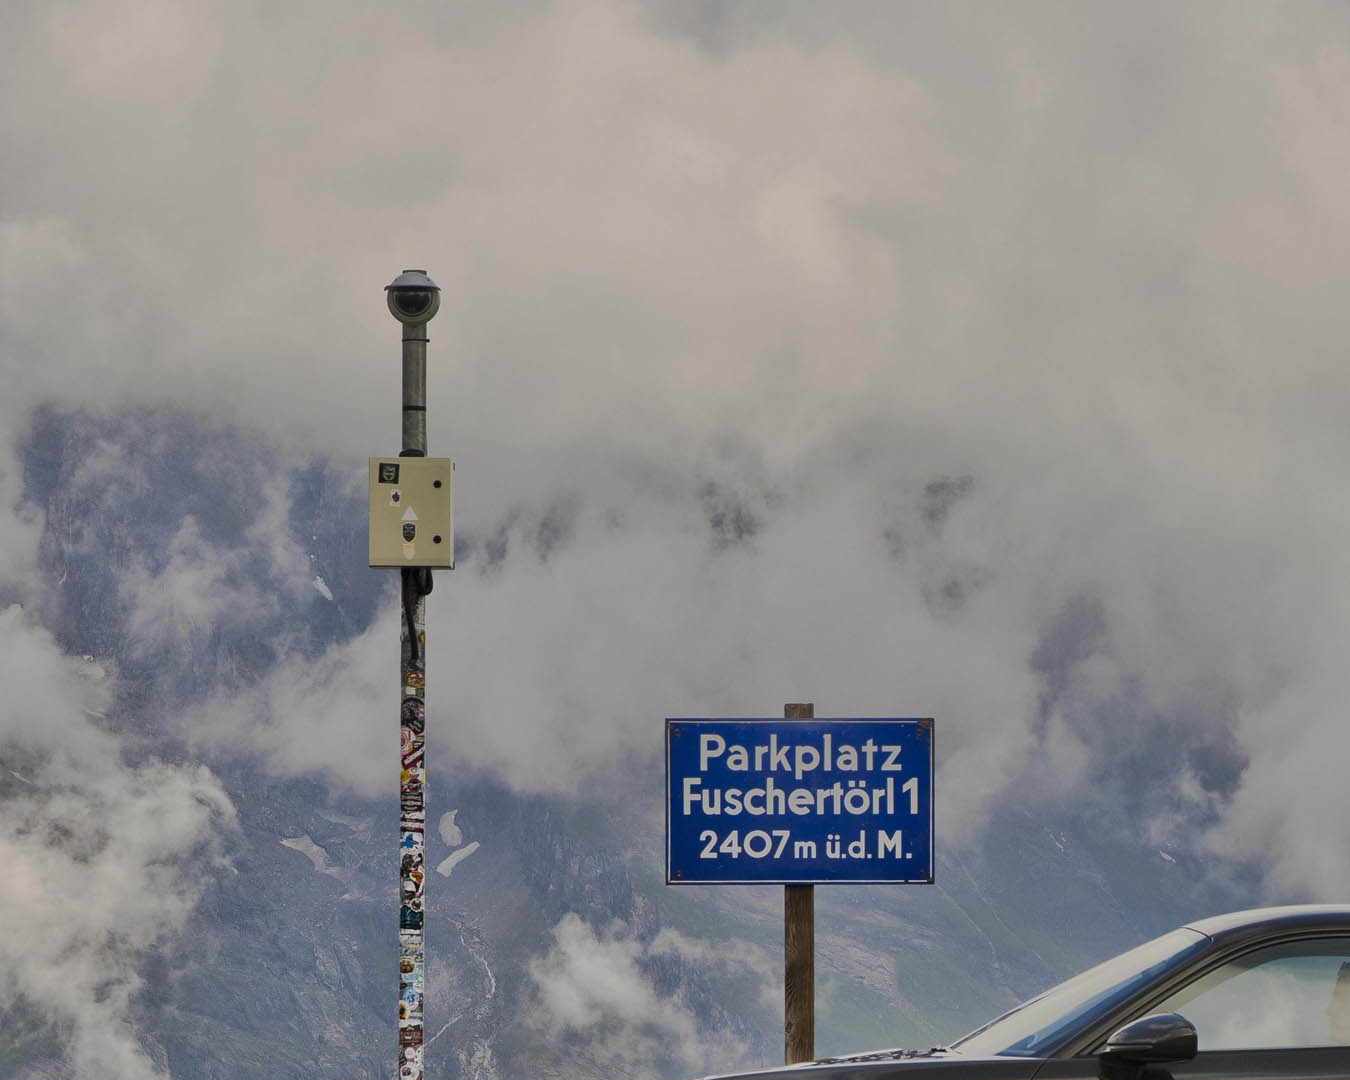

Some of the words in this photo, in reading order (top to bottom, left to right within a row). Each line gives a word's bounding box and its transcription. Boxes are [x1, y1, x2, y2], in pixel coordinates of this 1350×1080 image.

[699, 734, 902, 780] Parkplatz
[683, 777, 894, 816] Fuschertörl
[902, 777, 919, 815] 1
